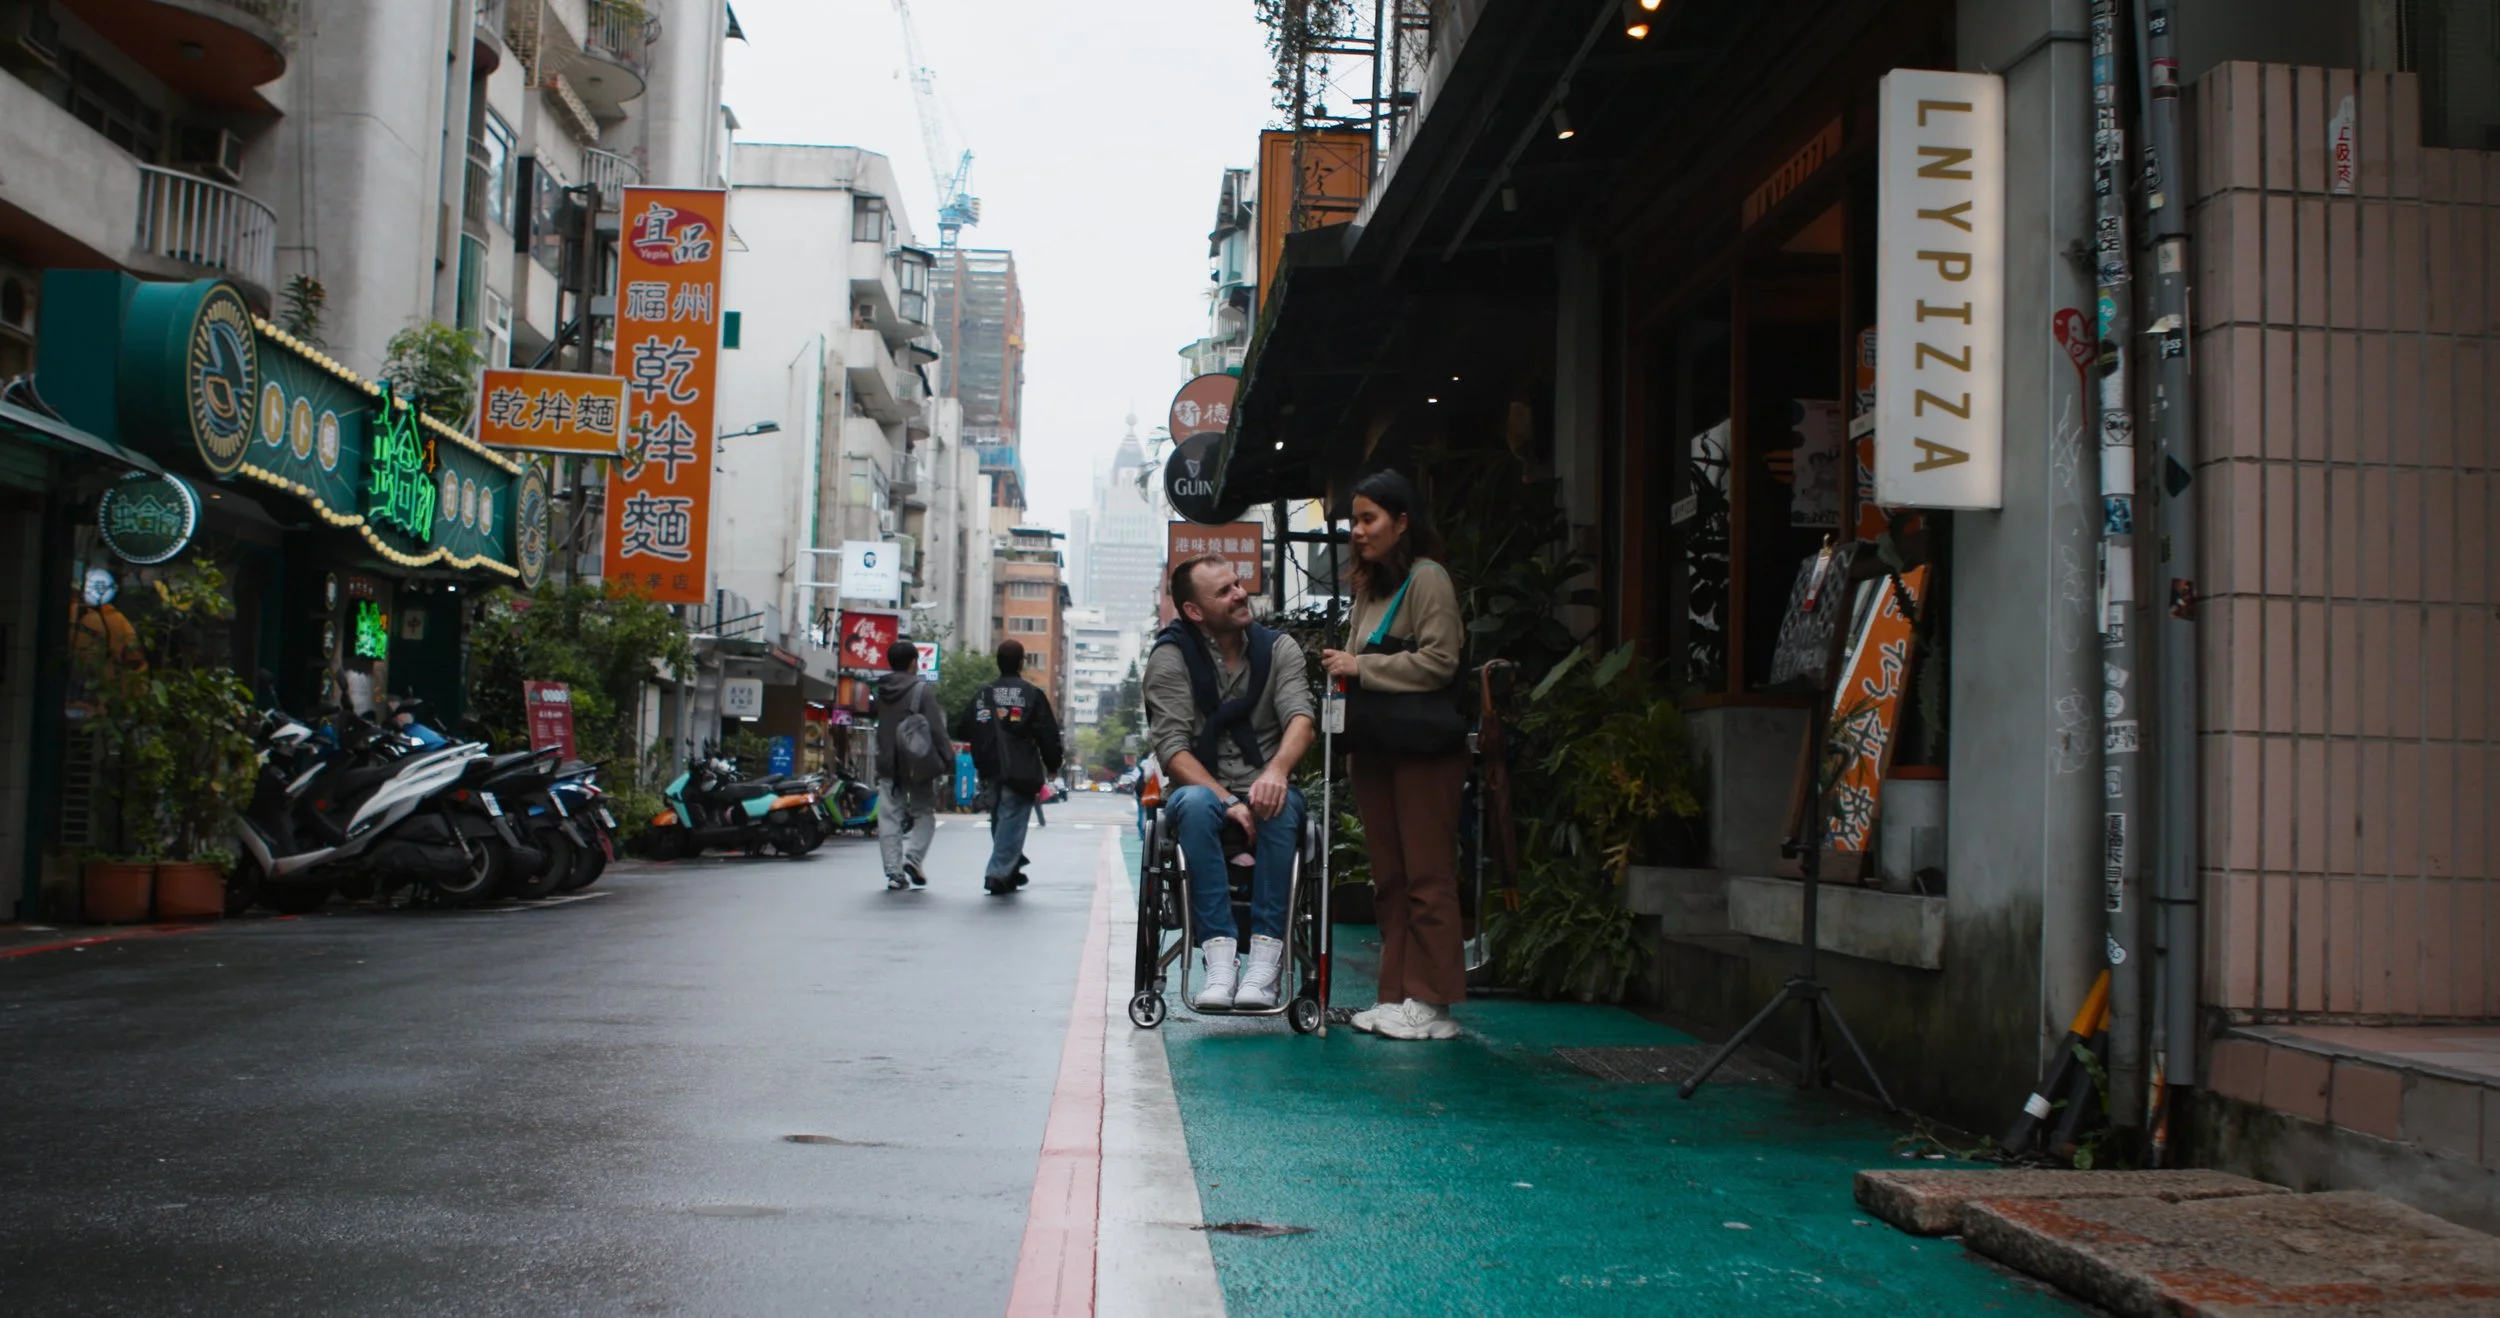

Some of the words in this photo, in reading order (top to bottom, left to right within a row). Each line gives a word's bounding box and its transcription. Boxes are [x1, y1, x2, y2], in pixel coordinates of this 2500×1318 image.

[632, 202, 712, 264] 宜品
[640, 248, 669, 260] Yepin
[625, 281, 713, 325] 福州
[1914, 100, 1973, 473] LNYPIZZA
[487, 388, 619, 434] 乾拌麵
[619, 336, 701, 562] 乾拌麵
